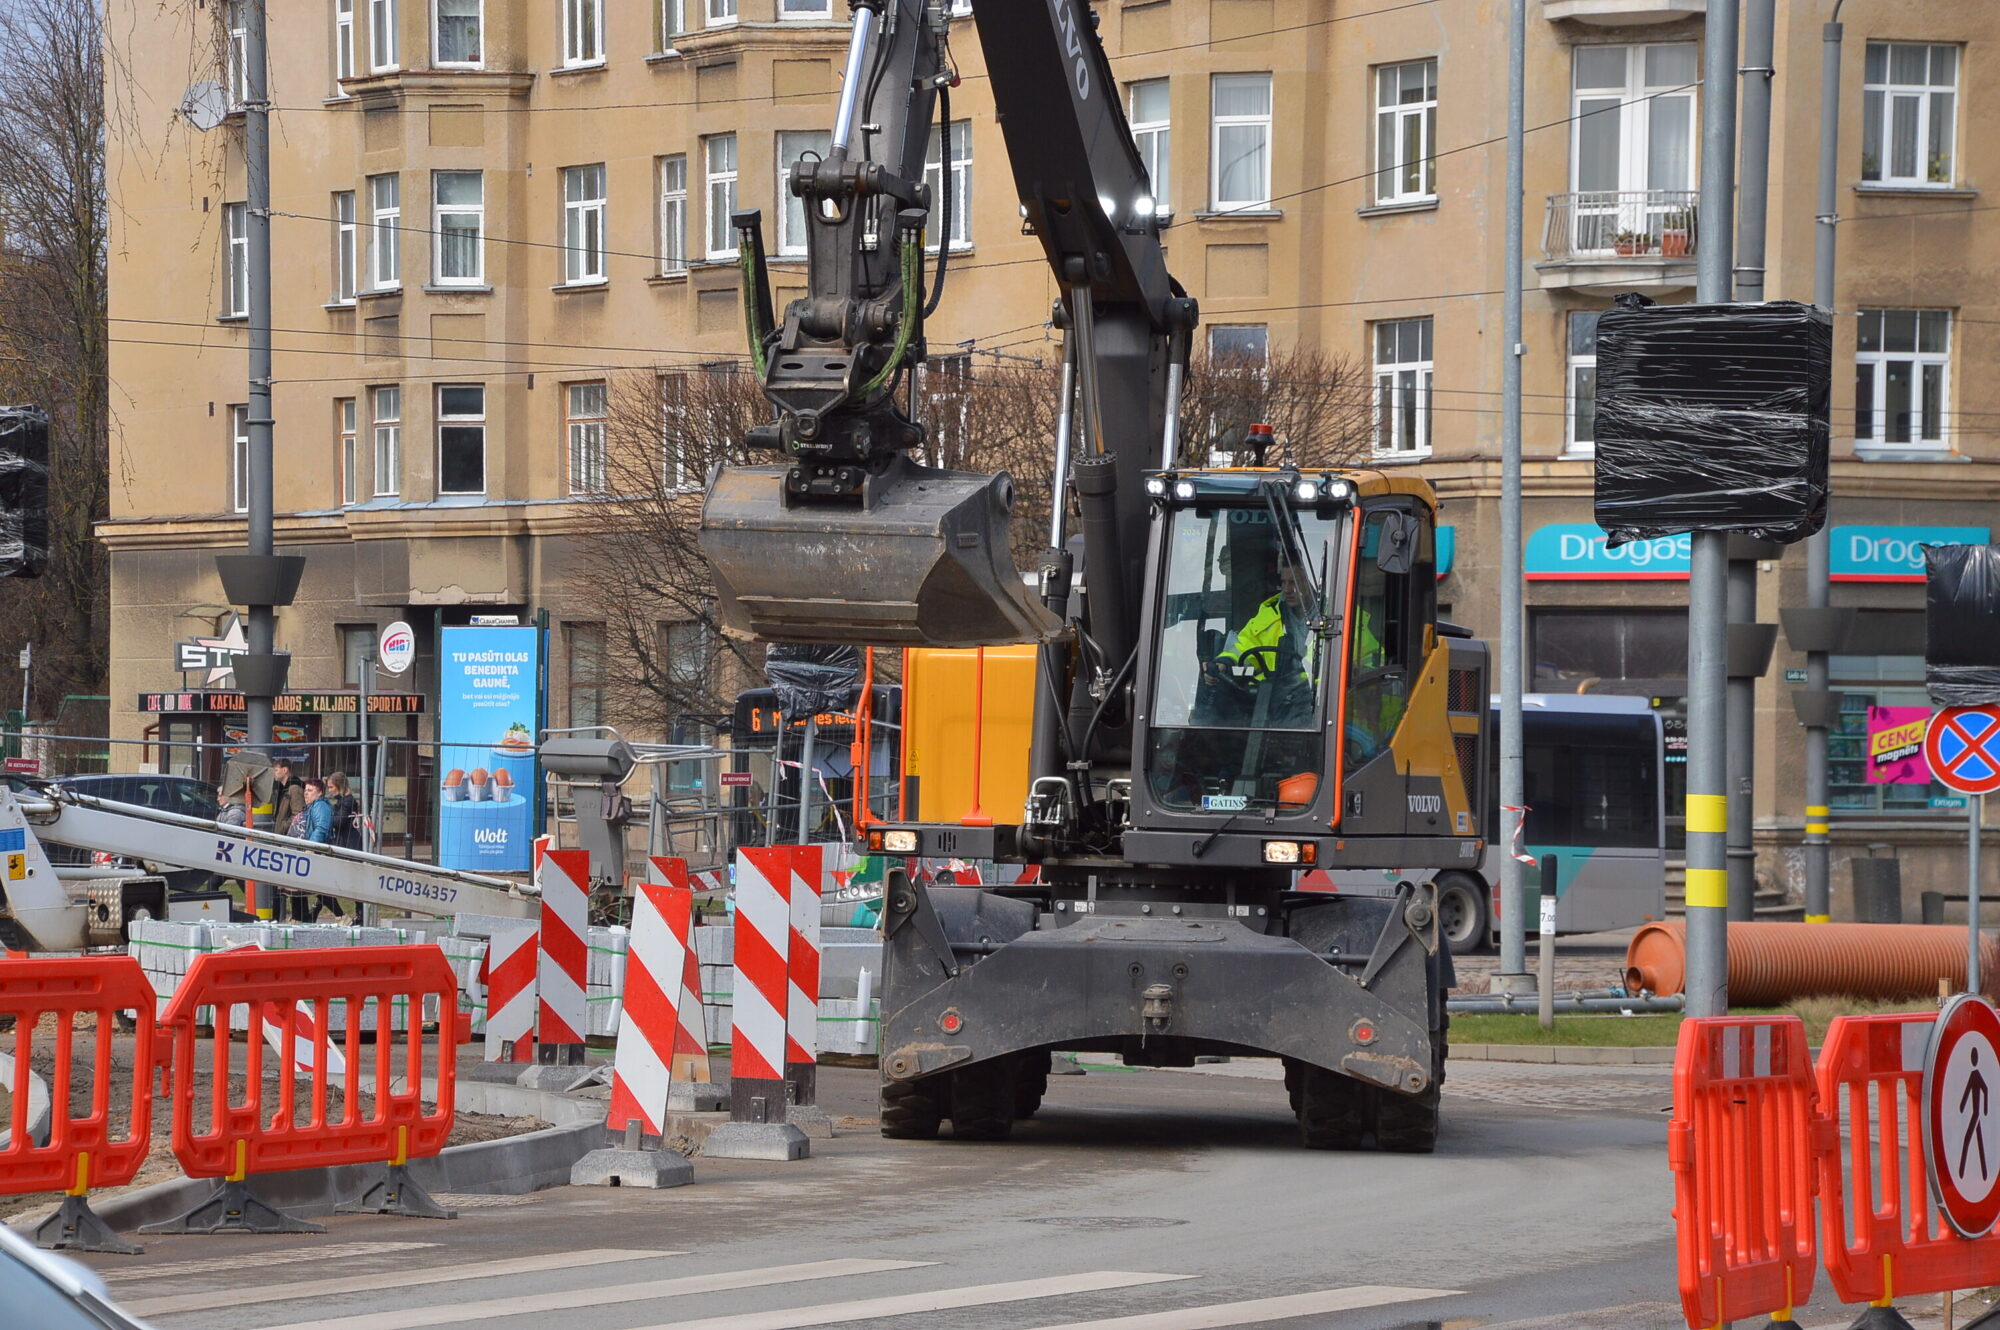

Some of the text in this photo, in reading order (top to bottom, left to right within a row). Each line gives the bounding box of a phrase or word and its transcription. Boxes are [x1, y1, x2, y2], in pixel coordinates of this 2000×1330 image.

[1561, 534, 1691, 566] Drogas
[452, 649, 529, 663] TU PASŪTI OLAS
[464, 665, 519, 675] BENEDIKTA
[210, 695, 245, 711] KAFIJA
[367, 696, 418, 712] SPORTA TV
[752, 708, 761, 732] 6
[1407, 795, 1441, 813] VOLVO
[474, 828, 508, 843] Wolt
[242, 846, 311, 877] KESTO
[378, 875, 457, 903] 1CP034357
